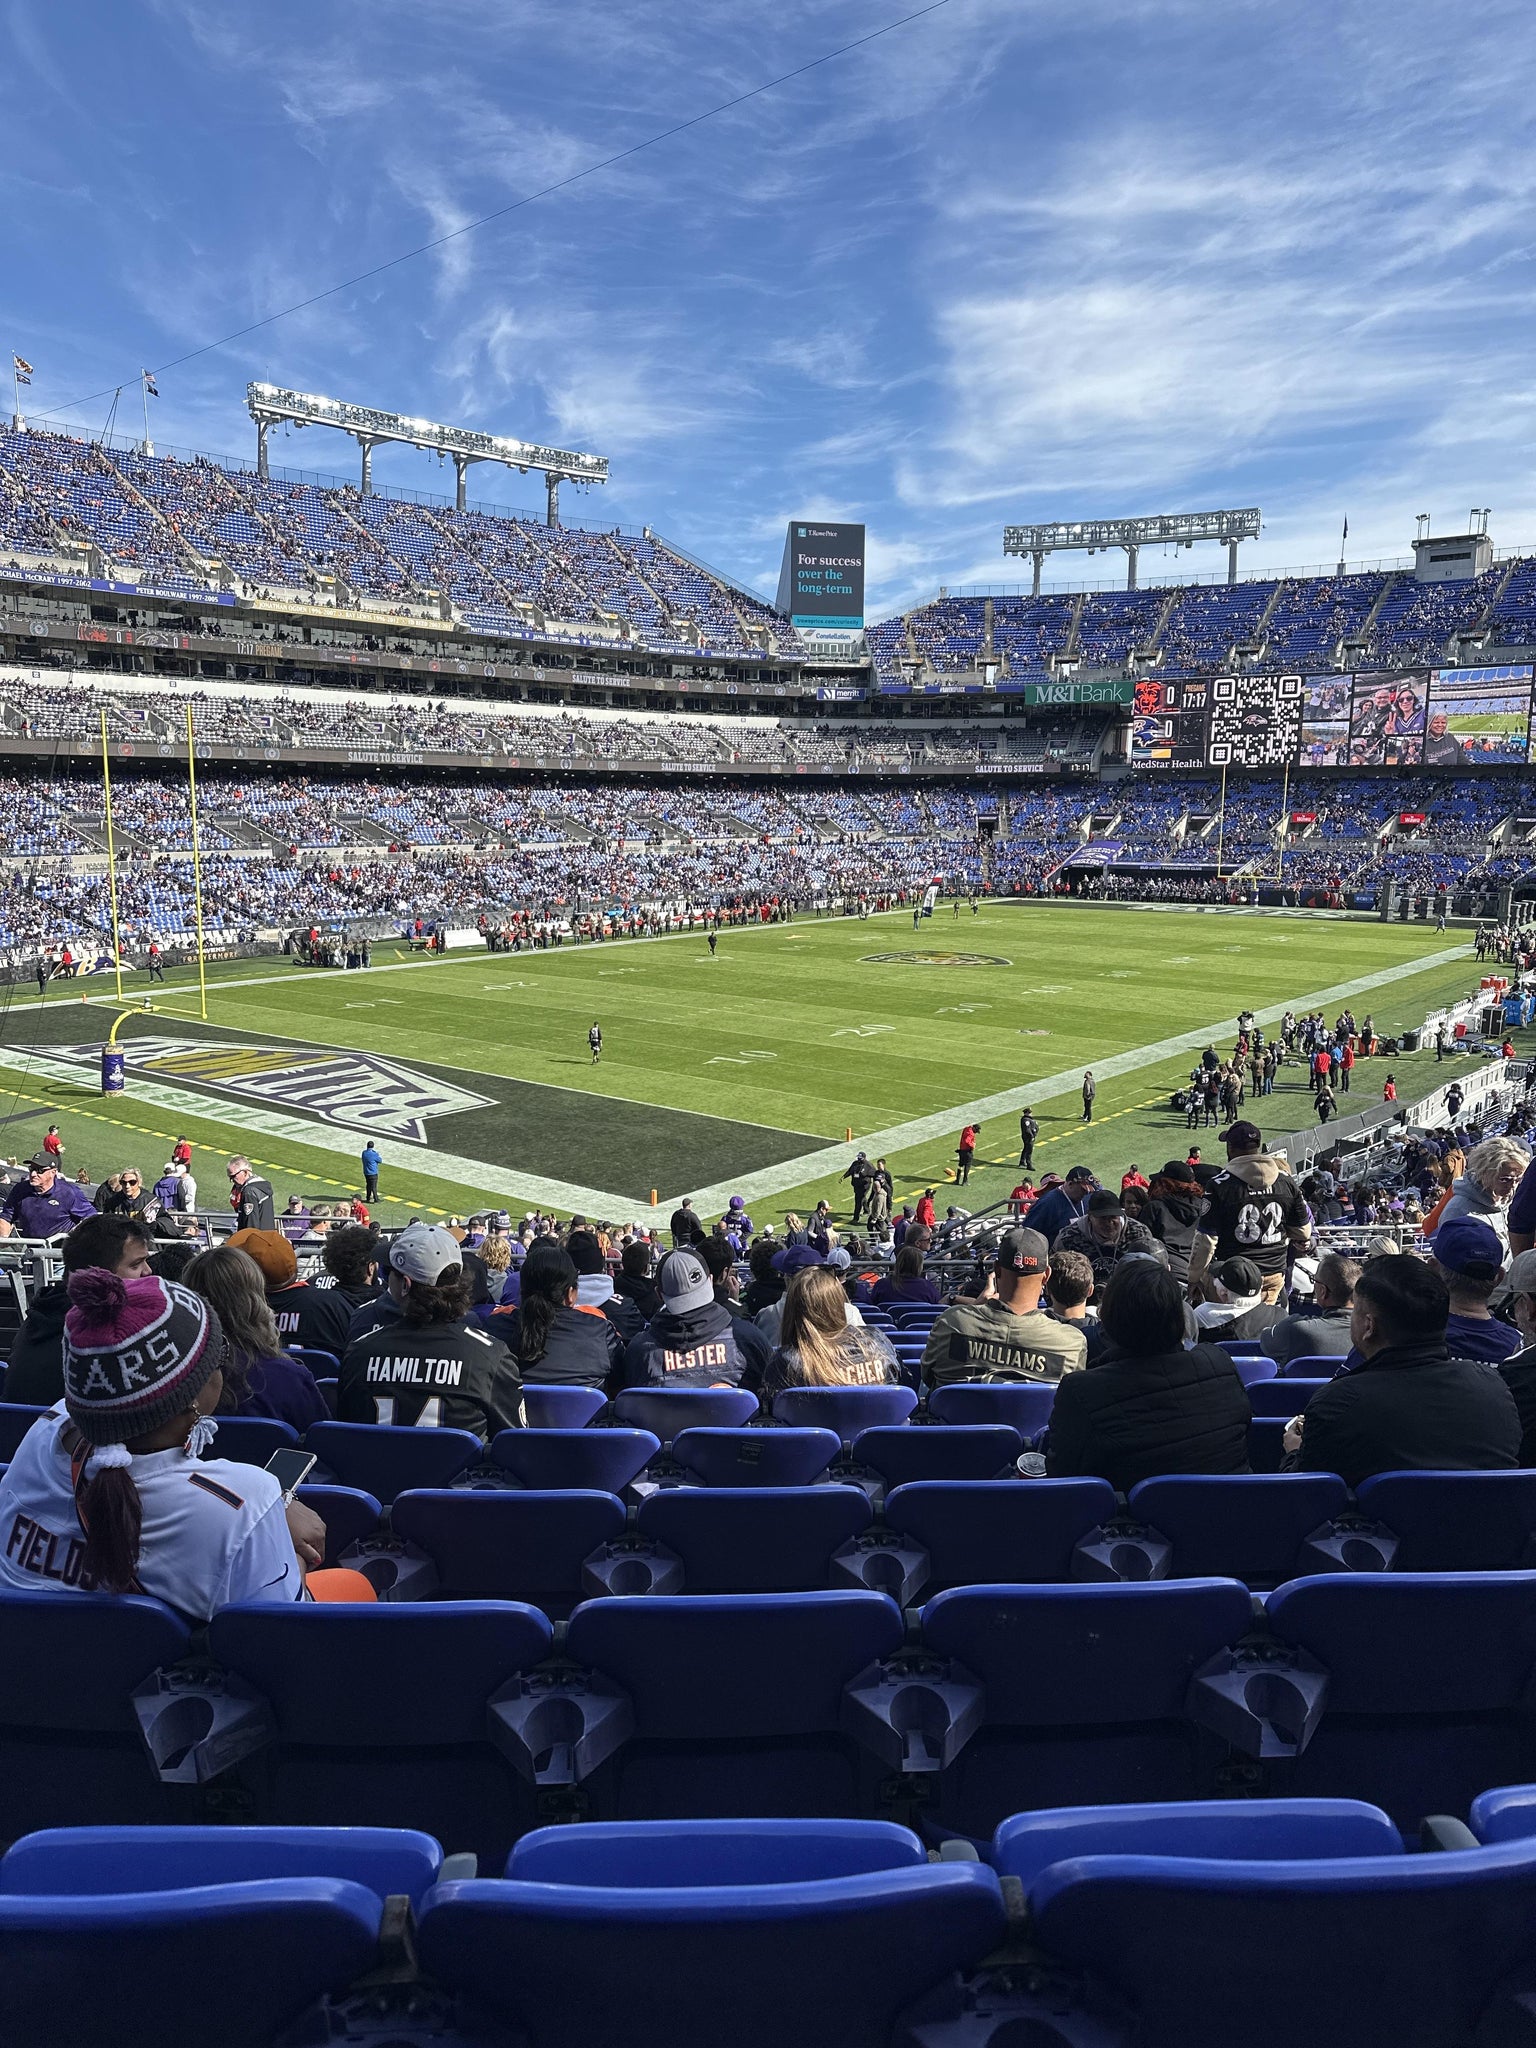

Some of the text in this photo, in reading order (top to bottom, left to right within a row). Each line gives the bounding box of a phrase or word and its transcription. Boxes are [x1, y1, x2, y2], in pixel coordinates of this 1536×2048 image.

[798, 554, 862, 566] For success
[0, 570, 23, 579] ICHAEL
[798, 569, 843, 580] over the
[136, 587, 219, 603] PETER BOULWARE 1997-2005
[798, 582, 853, 595] long-term
[237, 642, 284, 657] 17:17 PREGAME
[572, 674, 631, 687] SALUTE TO SERVICE
[1185, 684, 1206, 692] PREGAME
[1035, 684, 1123, 703] M&T Bank
[1167, 687, 1175, 705] 0
[1182, 692, 1207, 708] 17:17
[1164, 720, 1173, 738] 0
[348, 752, 424, 764] SALUTE TO SERVICE
[1132, 759, 1203, 769] MedStar Health
[661, 763, 716, 772] SALUTE TO SERVICE
[975, 764, 1044, 773] SALUTE TO SERVICE
[182, 951, 239, 962] FORVERMORE
[1235, 1201, 1283, 1245] 82
[664, 1343, 727, 1371] HESTER
[967, 1340, 1046, 1373] WILLIAMS
[366, 1356, 463, 1386] HAMILTON
[373, 1396, 445, 1428] 14
[6, 1513, 99, 1591] FIELD
